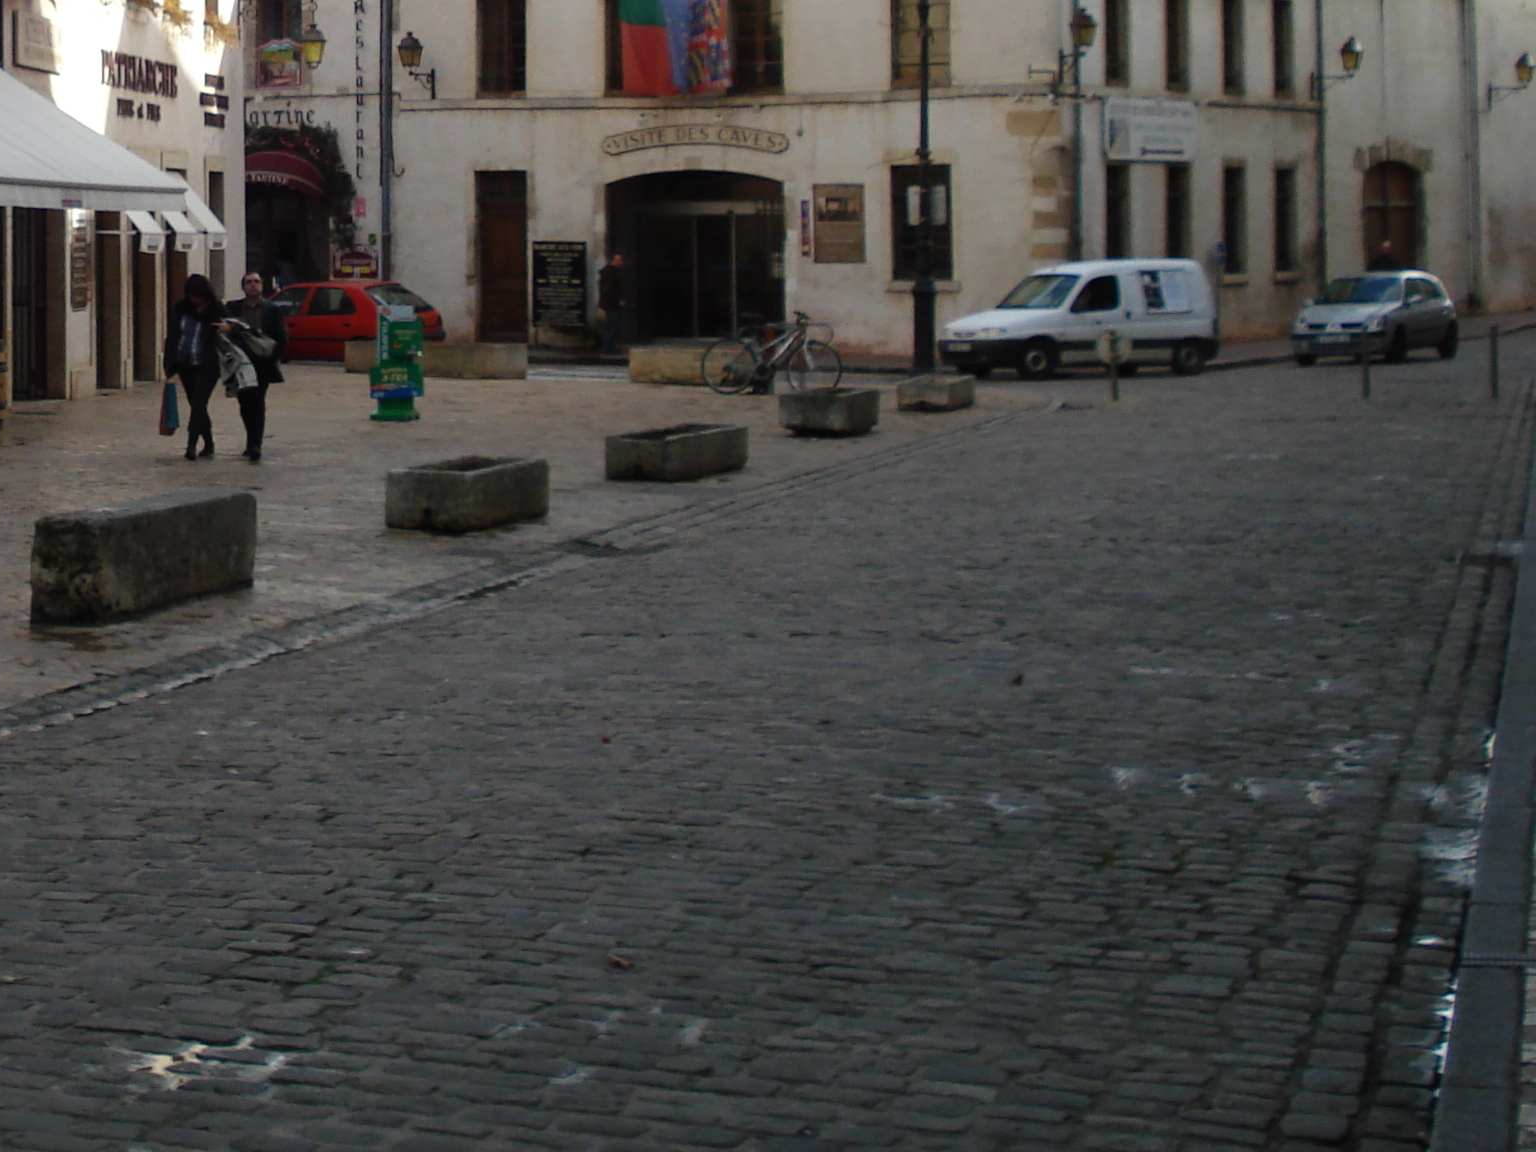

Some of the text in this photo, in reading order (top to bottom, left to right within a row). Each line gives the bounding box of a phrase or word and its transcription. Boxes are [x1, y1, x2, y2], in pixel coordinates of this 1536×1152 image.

[101, 48, 178, 99] PATRIARCHE
[245, 100, 316, 125] artine
[610, 127, 777, 148] VISITE DES CAVES
